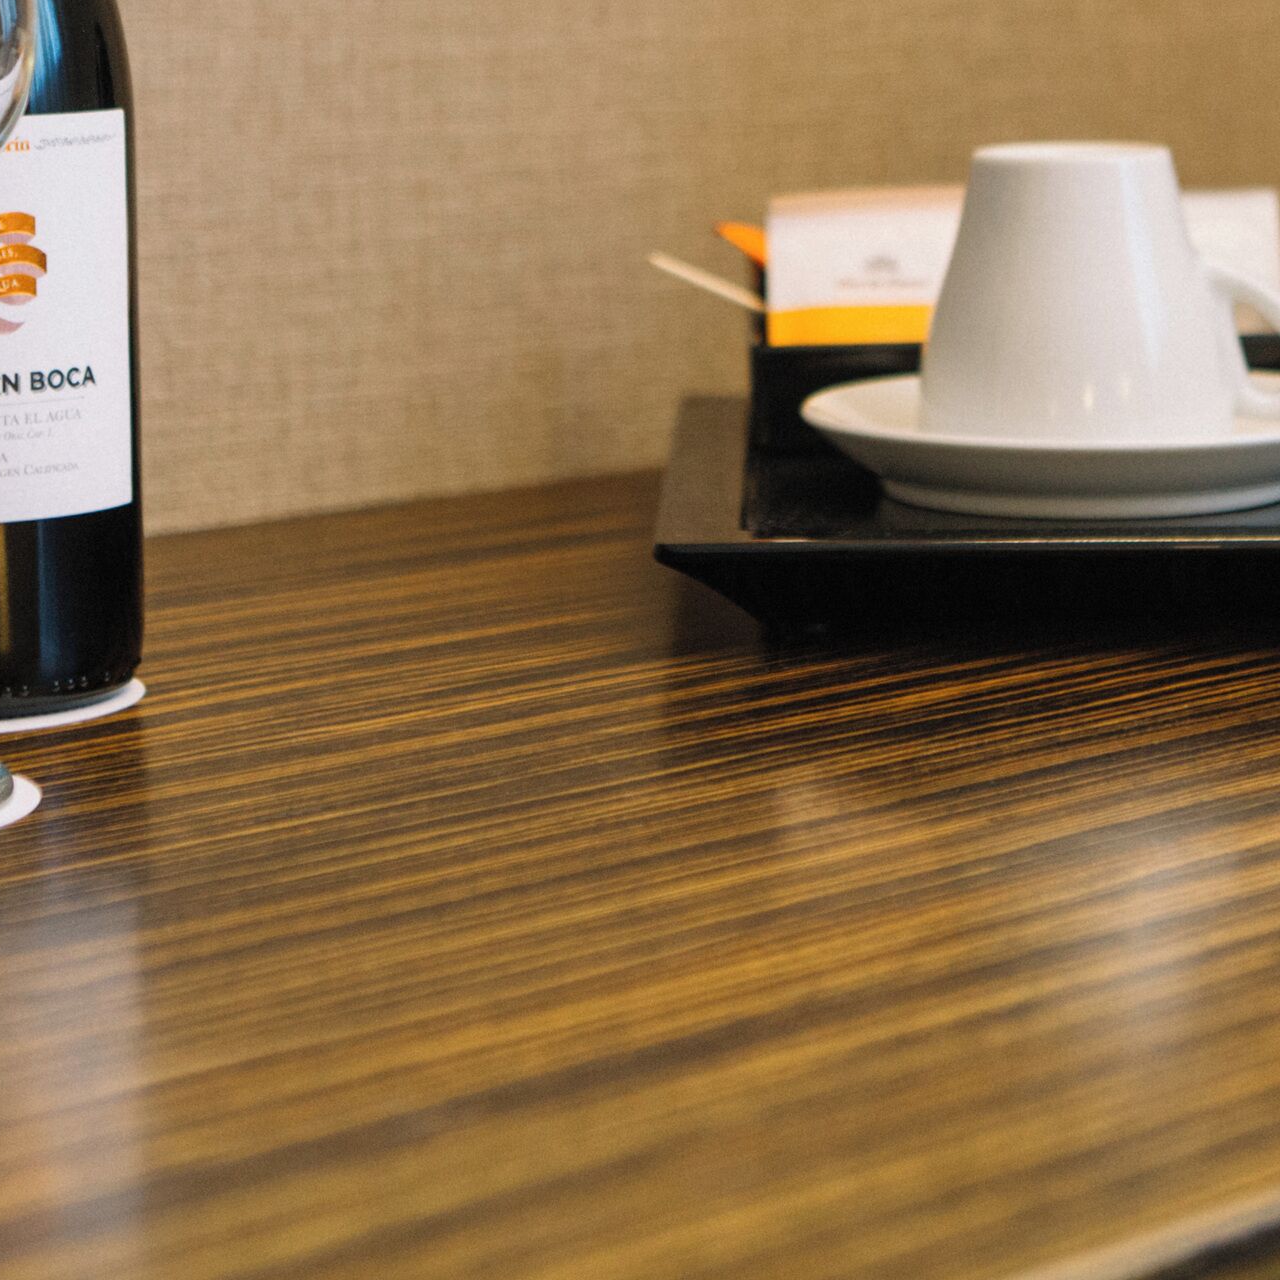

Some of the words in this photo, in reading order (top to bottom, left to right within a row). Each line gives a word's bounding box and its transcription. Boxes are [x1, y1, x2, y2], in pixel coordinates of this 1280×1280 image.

[30, 365, 97, 392] BOCA
[24, 412, 42, 426] EL
[45, 408, 82, 422] AGUA
